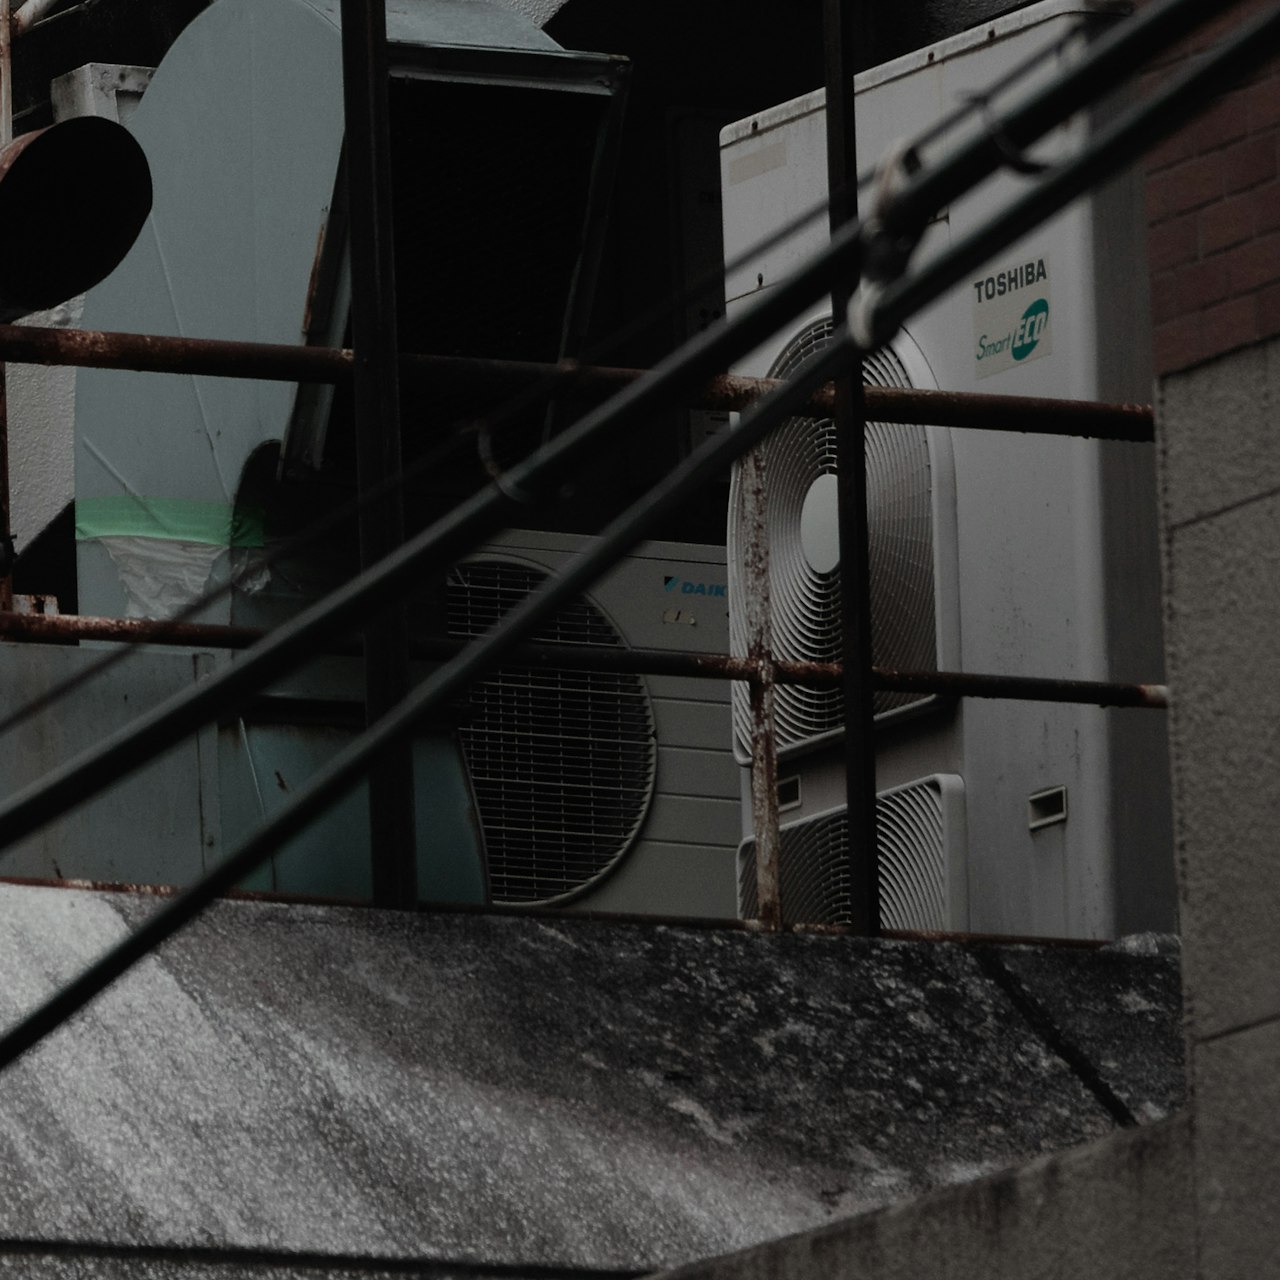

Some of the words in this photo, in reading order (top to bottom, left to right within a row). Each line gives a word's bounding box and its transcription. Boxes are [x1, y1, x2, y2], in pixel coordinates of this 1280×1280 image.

[974, 259, 1047, 303] TOSHIBA
[976, 332, 1011, 361] Smart
[1012, 310, 1048, 349] ECO
